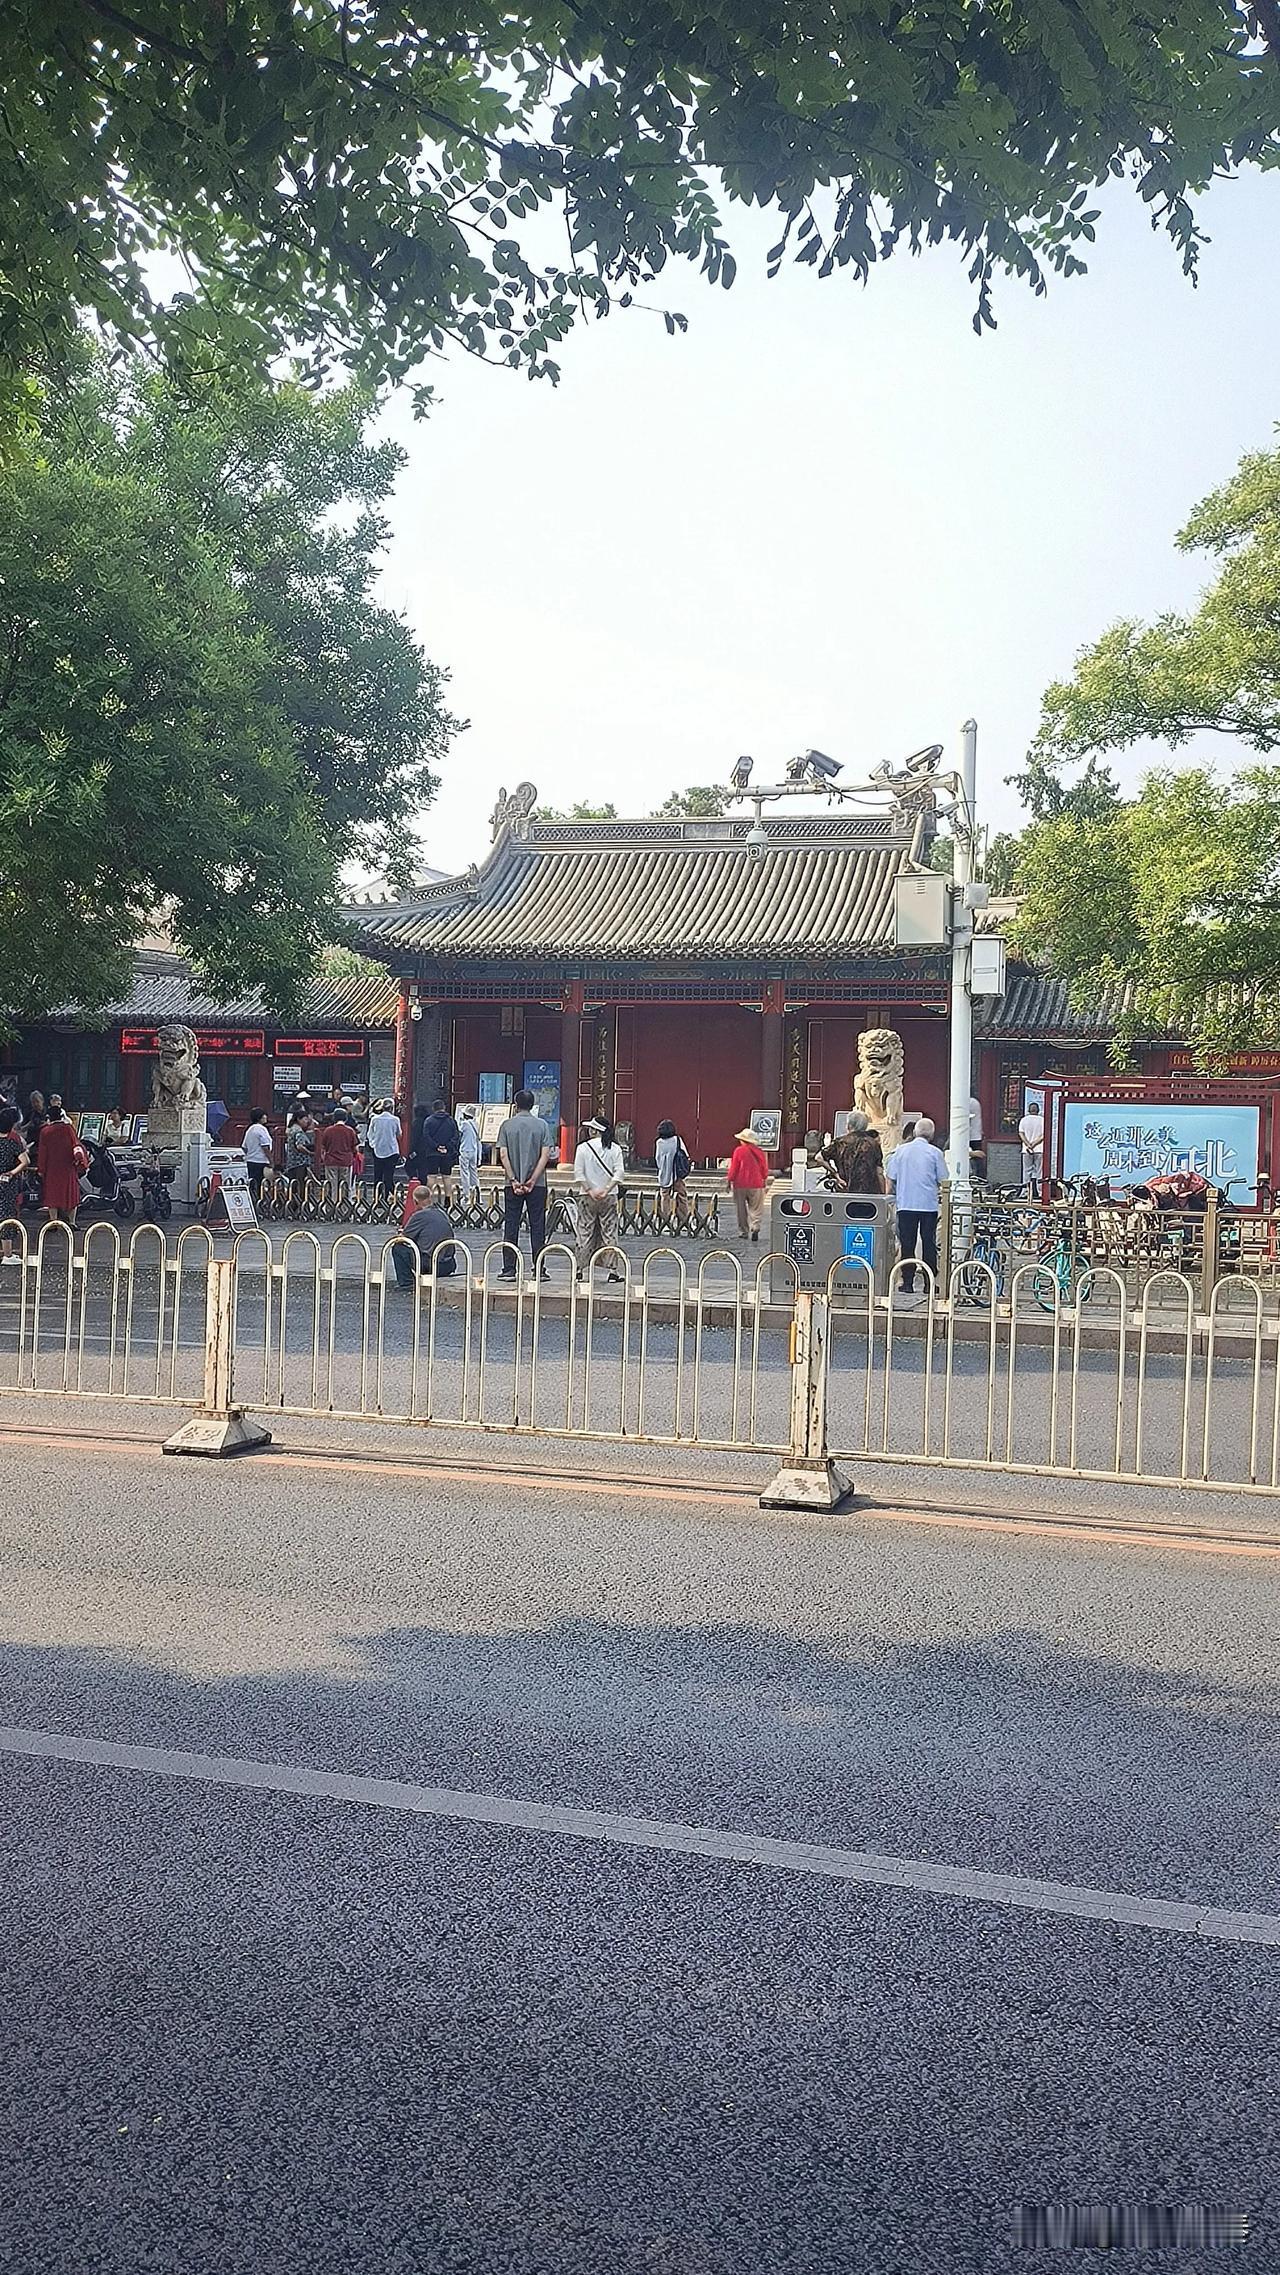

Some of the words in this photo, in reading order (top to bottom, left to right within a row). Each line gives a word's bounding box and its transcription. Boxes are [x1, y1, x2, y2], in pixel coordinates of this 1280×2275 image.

[1084, 1122, 1179, 1148] 这么近那么美
[1103, 1140, 1238, 1178] 周末到河北
